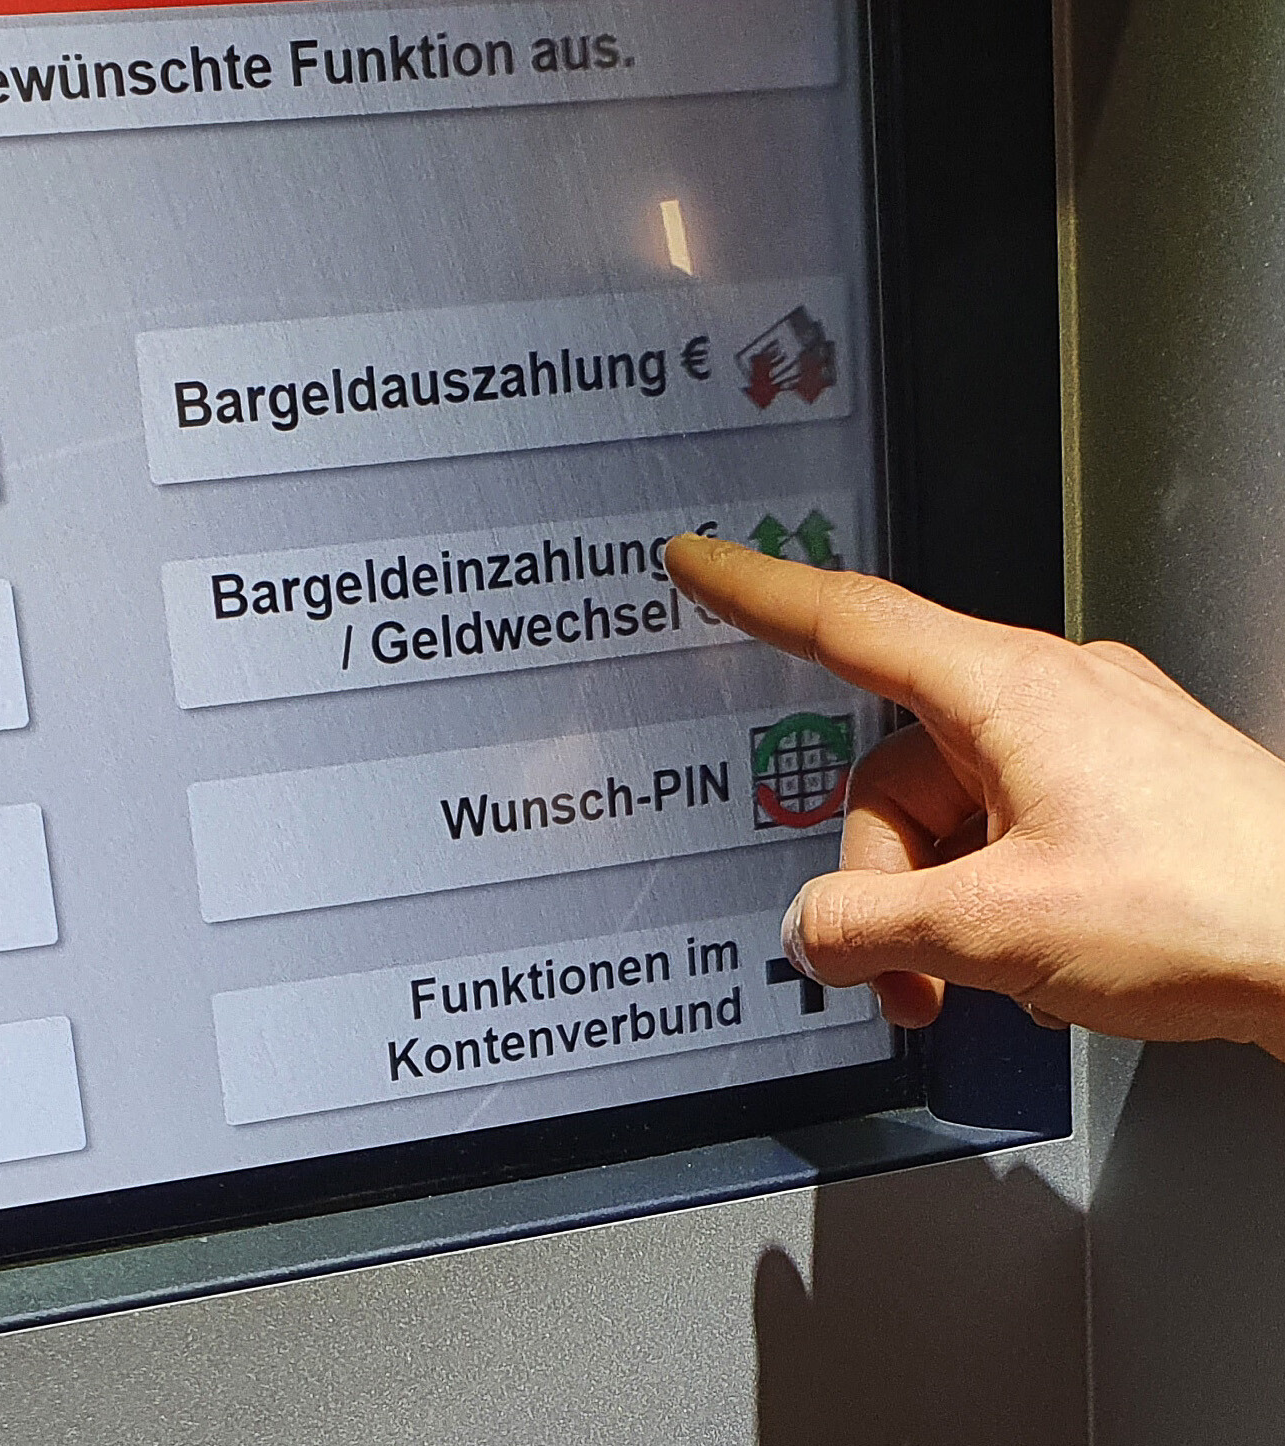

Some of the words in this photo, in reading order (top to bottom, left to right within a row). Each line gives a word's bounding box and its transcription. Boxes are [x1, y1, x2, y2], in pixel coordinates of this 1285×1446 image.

[291, 33, 513, 89] Funktion
[530, 29, 636, 74] aus.
[173, 338, 668, 431] Bargeldauszahlung
[679, 336, 713, 383] €
[341, 624, 355, 671] /
[371, 587, 681, 667] Geldwechsel
[440, 762, 731, 841] Wunsch-PIN
[410, 947, 671, 1022] Funktionen
[685, 937, 740, 980] im
[387, 987, 743, 1082] Kontenverbund
